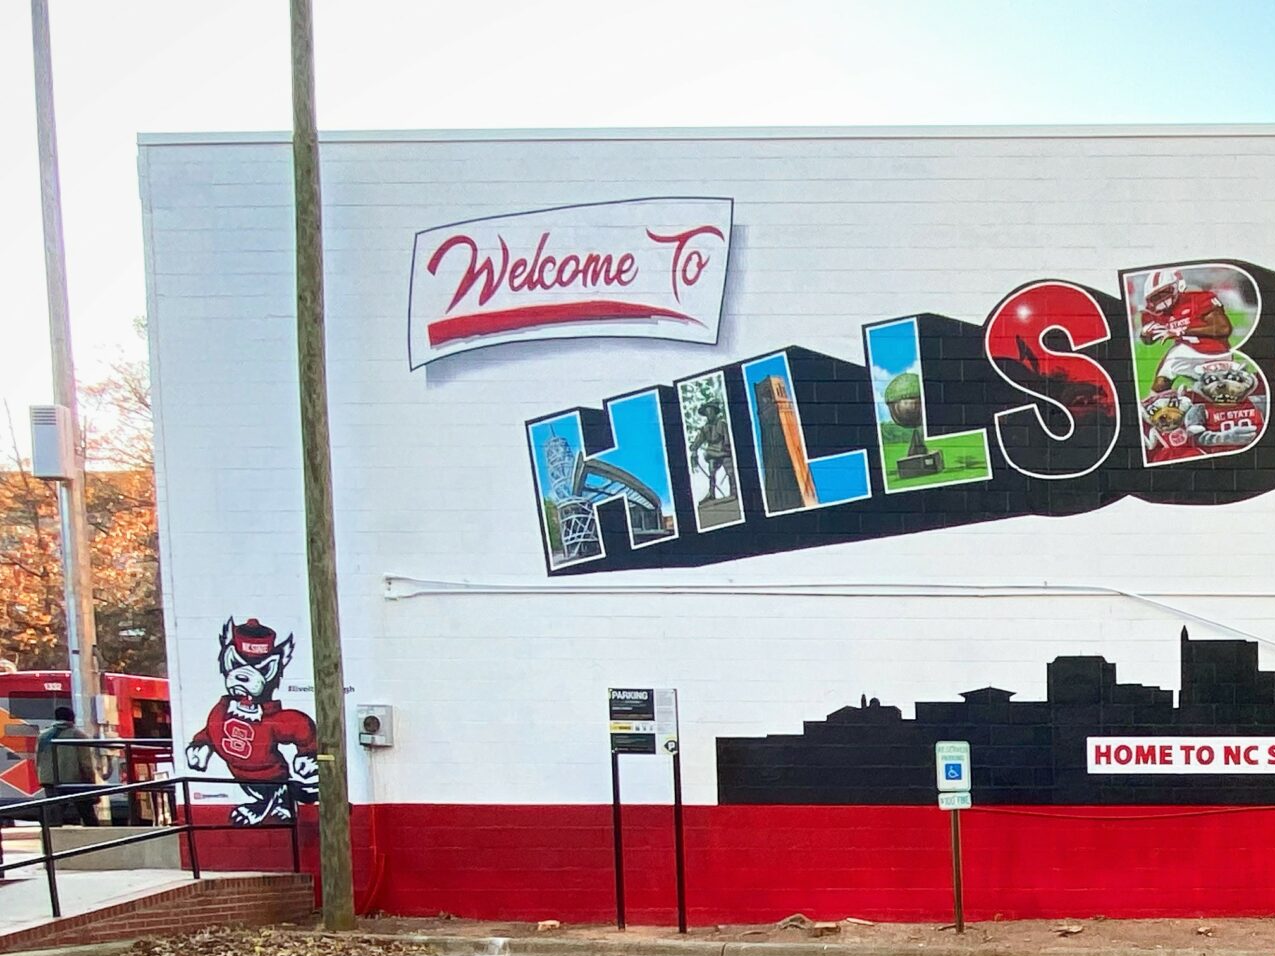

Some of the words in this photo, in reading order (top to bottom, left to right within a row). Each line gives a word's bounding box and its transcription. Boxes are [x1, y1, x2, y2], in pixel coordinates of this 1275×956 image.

[428, 232, 639, 315] Welcome
[646, 225, 725, 303] To
[612, 691, 649, 700] PARKING
[1094, 744, 1173, 766] HOME
[1180, 744, 1215, 766] TO
[1223, 744, 1259, 765] NC
